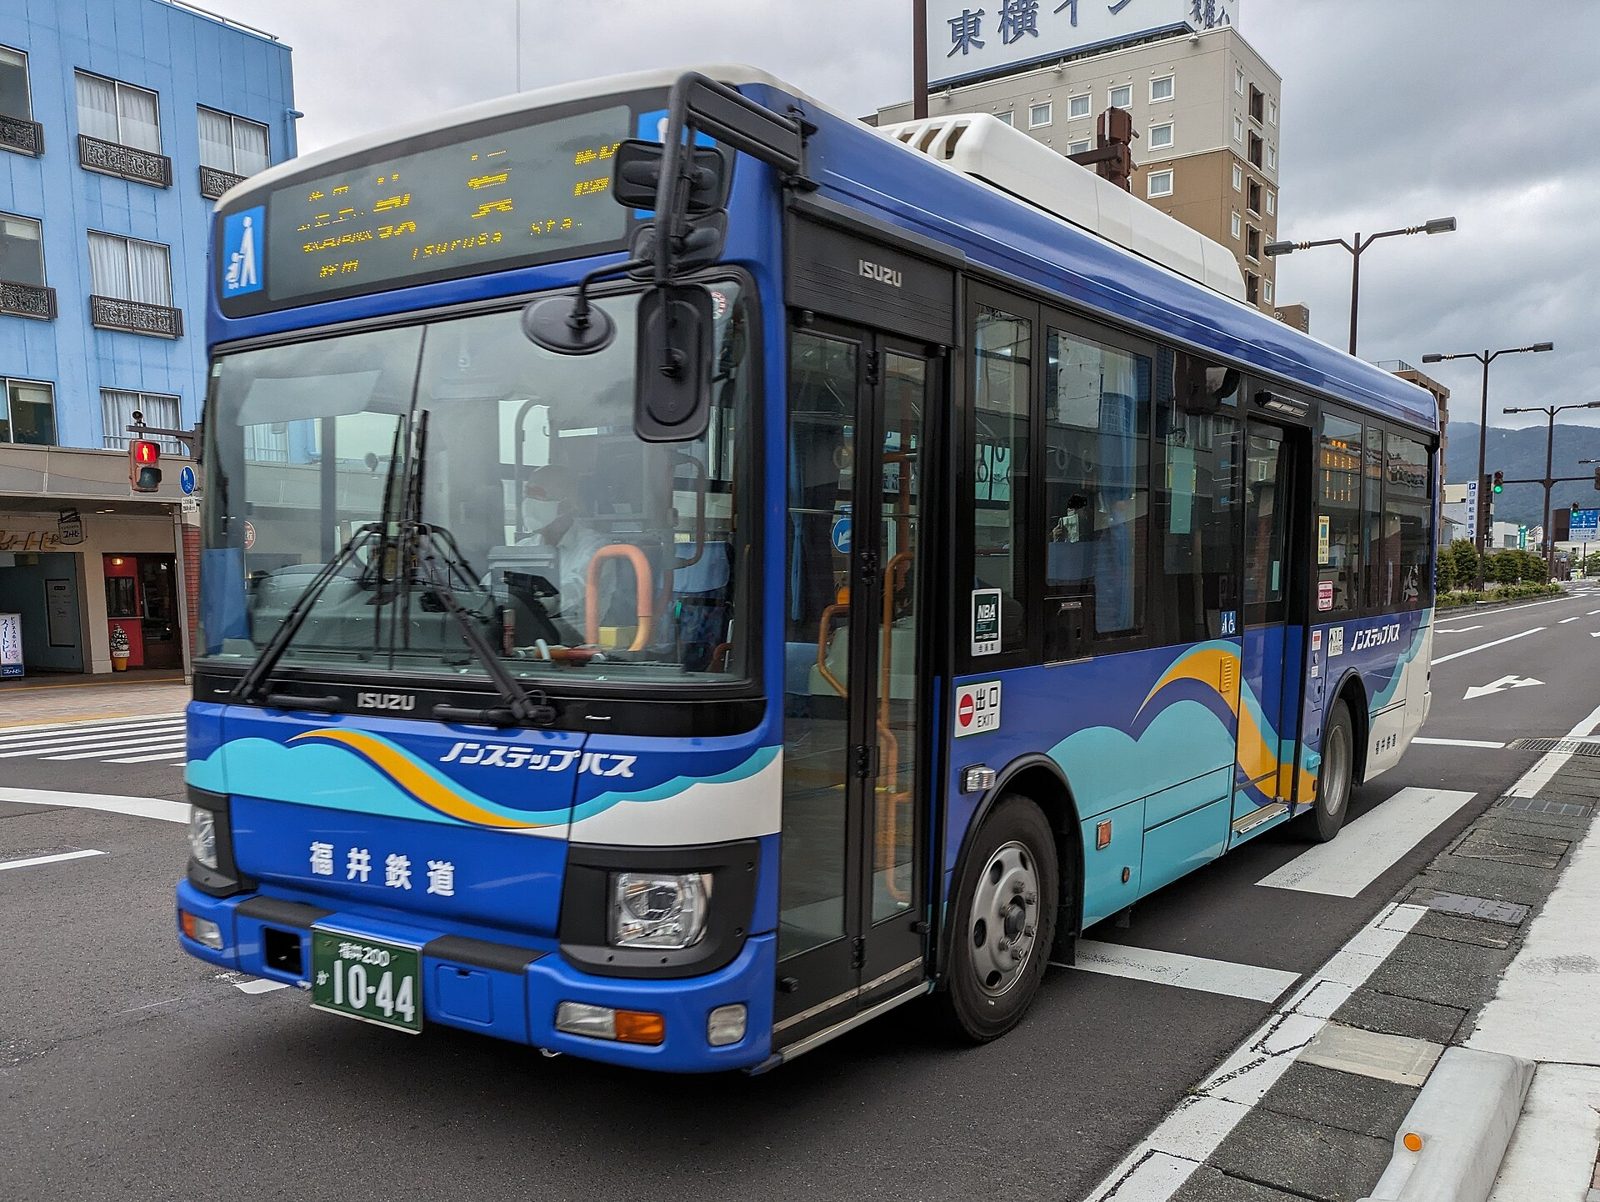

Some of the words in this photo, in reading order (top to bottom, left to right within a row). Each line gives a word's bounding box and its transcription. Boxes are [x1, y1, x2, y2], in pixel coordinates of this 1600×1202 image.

[859, 259, 902, 288] ISUZU
[977, 604, 996, 619] NBA
[1350, 623, 1400, 652] ノンステップバス
[357, 692, 416, 711] ISUZU
[976, 686, 998, 711] 出口
[977, 712, 995, 728] EXIT
[439, 742, 638, 778] ノンステップバス
[309, 841, 455, 896] 福井鉄道
[333, 960, 416, 1023] 10-44
